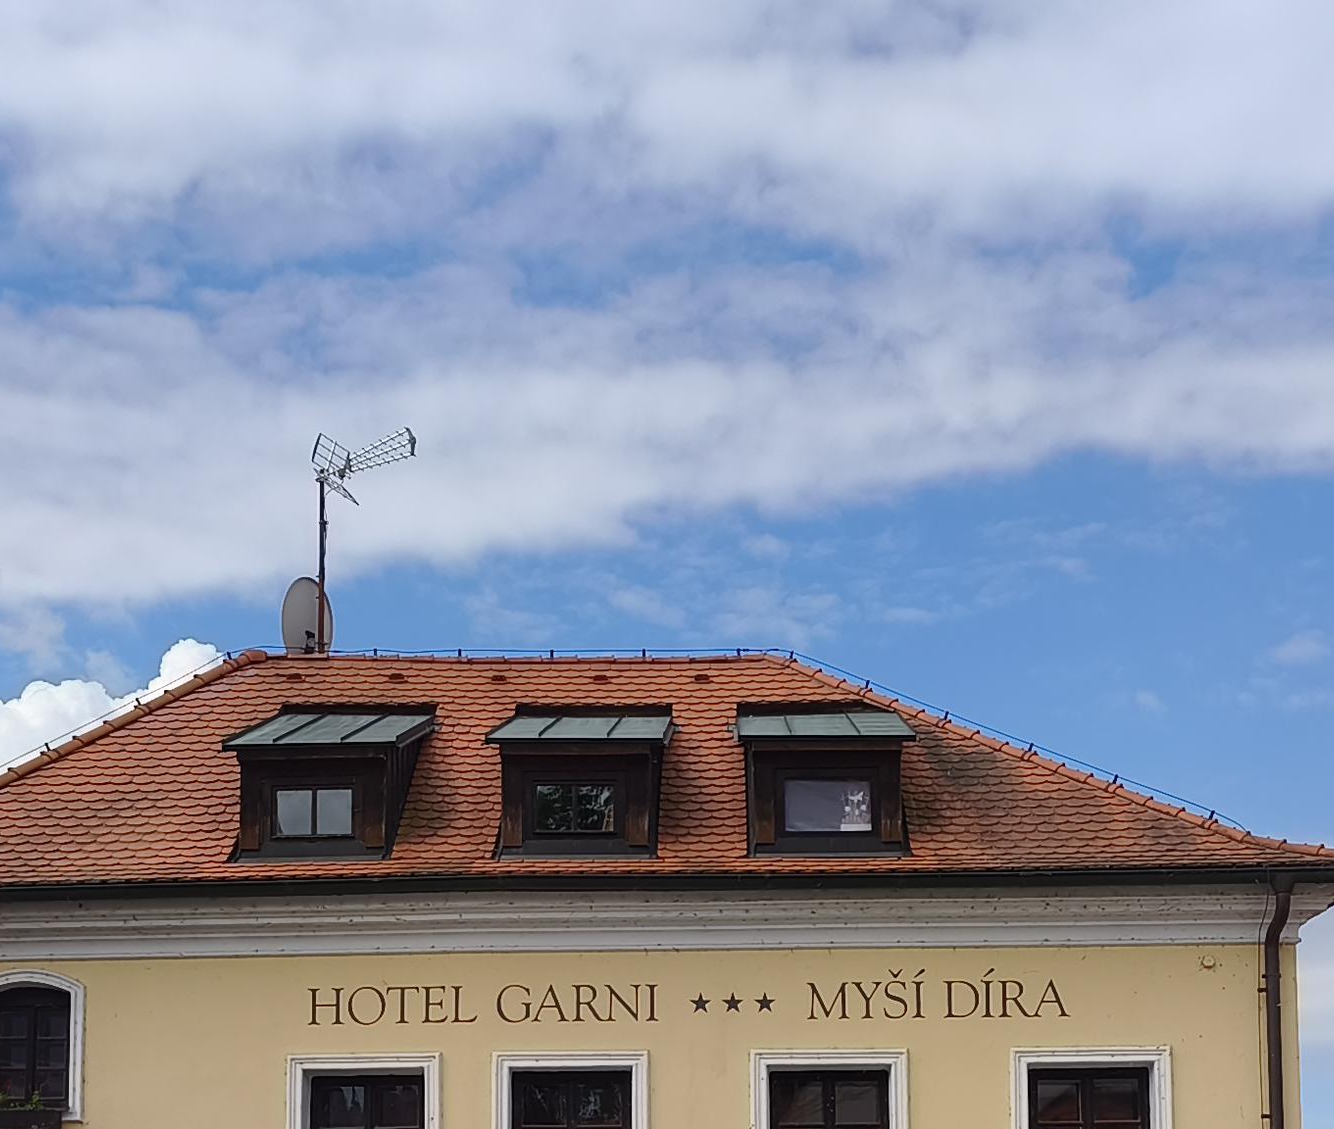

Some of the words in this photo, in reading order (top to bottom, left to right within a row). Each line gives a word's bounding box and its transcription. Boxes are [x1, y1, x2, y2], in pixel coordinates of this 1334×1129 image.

[307, 986, 478, 1026] HOTEL
[495, 983, 660, 1025] GARNI
[805, 968, 927, 1021] MYŠÍ
[943, 967, 1071, 1020] DÍRA
